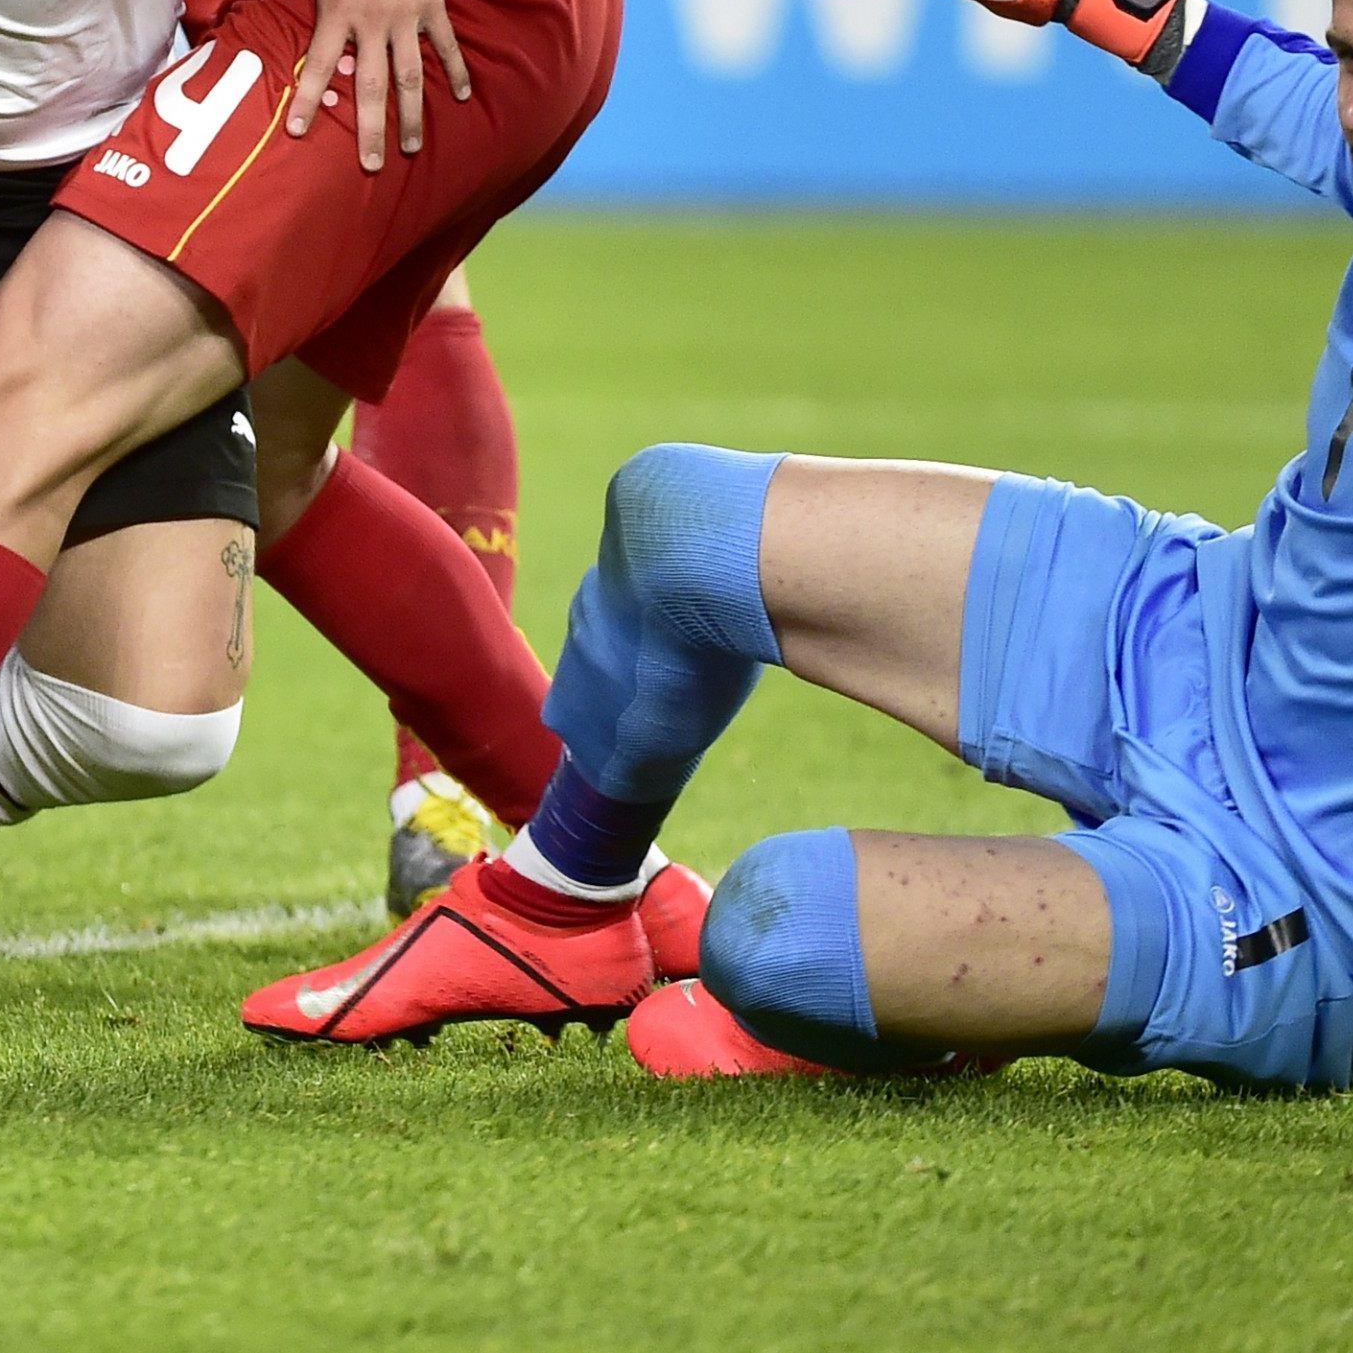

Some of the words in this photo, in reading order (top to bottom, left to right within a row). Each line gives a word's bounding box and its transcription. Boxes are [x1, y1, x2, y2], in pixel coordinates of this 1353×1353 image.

[154, 39, 264, 177] 4
[93, 149, 151, 188] JAKO
[1219, 914, 1238, 978] JAKO
